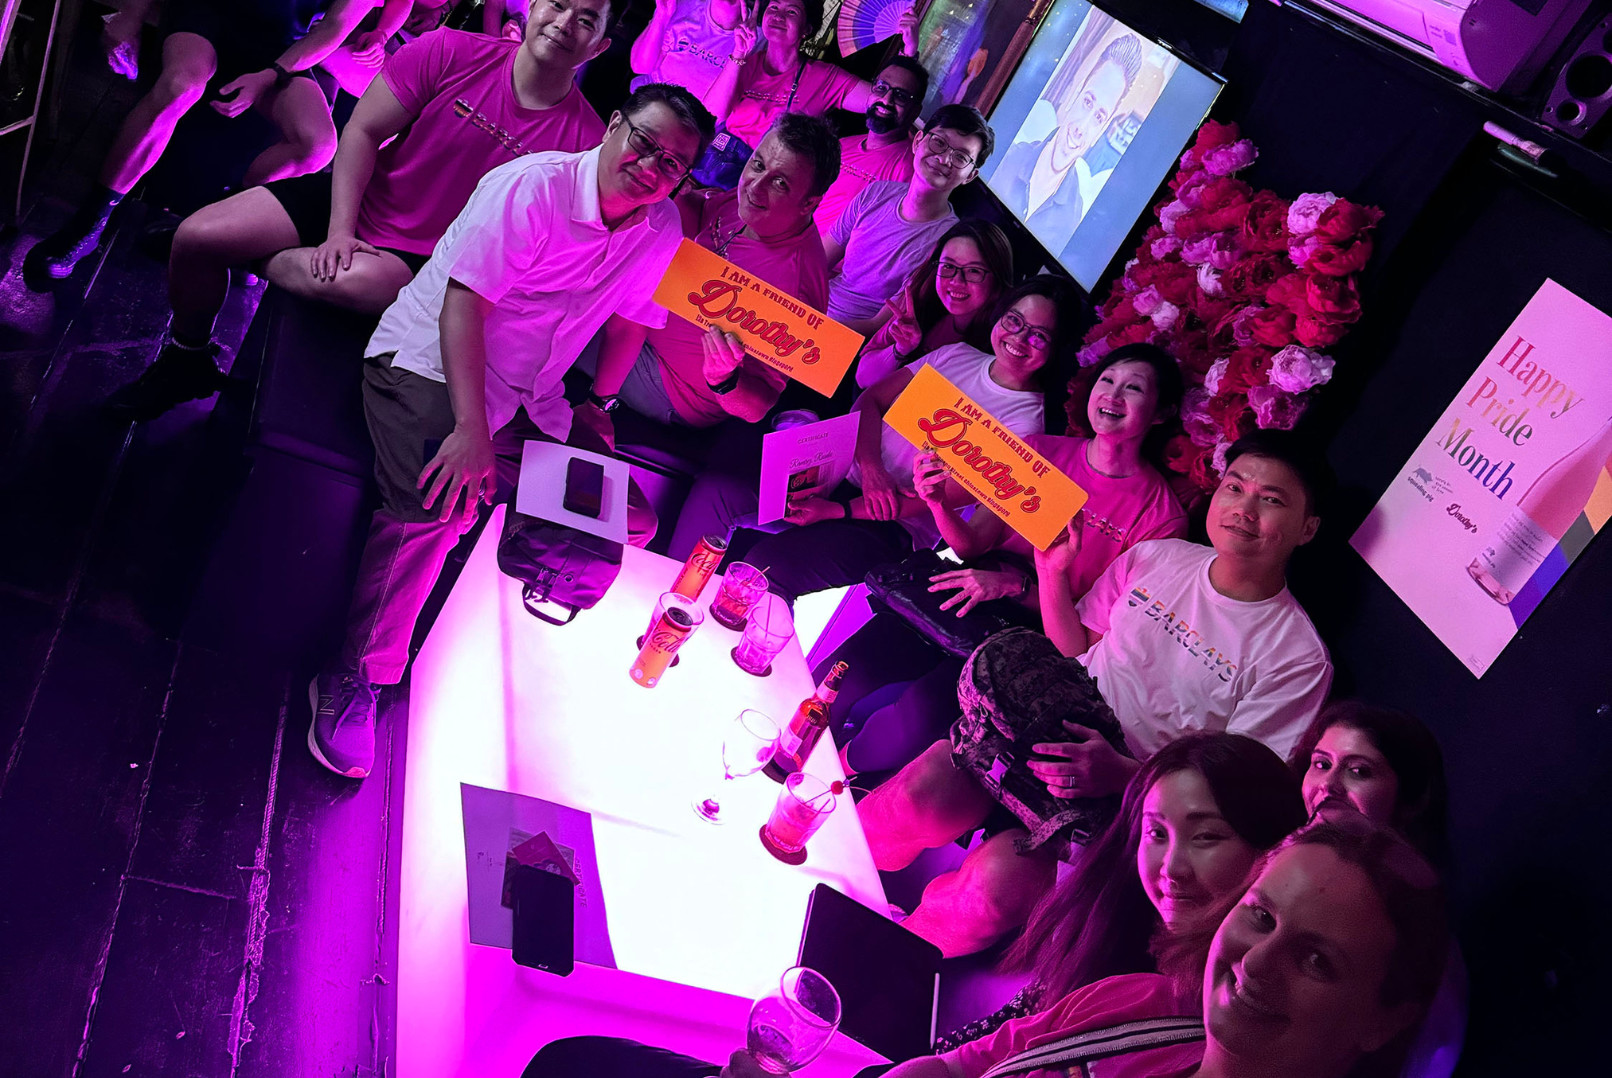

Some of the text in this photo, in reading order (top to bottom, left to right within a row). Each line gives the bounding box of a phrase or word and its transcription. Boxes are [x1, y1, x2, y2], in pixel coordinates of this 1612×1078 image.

[689, 42, 726, 69] BARCL
[687, 279, 821, 365] Dorothy's
[720, 266, 825, 330] I AM A FRIEND OF
[1466, 376, 1533, 446] Pride
[1496, 335, 1584, 419] Happy
[917, 408, 1042, 513] Dorothy's
[953, 397, 1051, 479] I AM A FRIEND OF
[1435, 416, 1516, 500] Month
[1145, 600, 1238, 682] BARCLAYS
